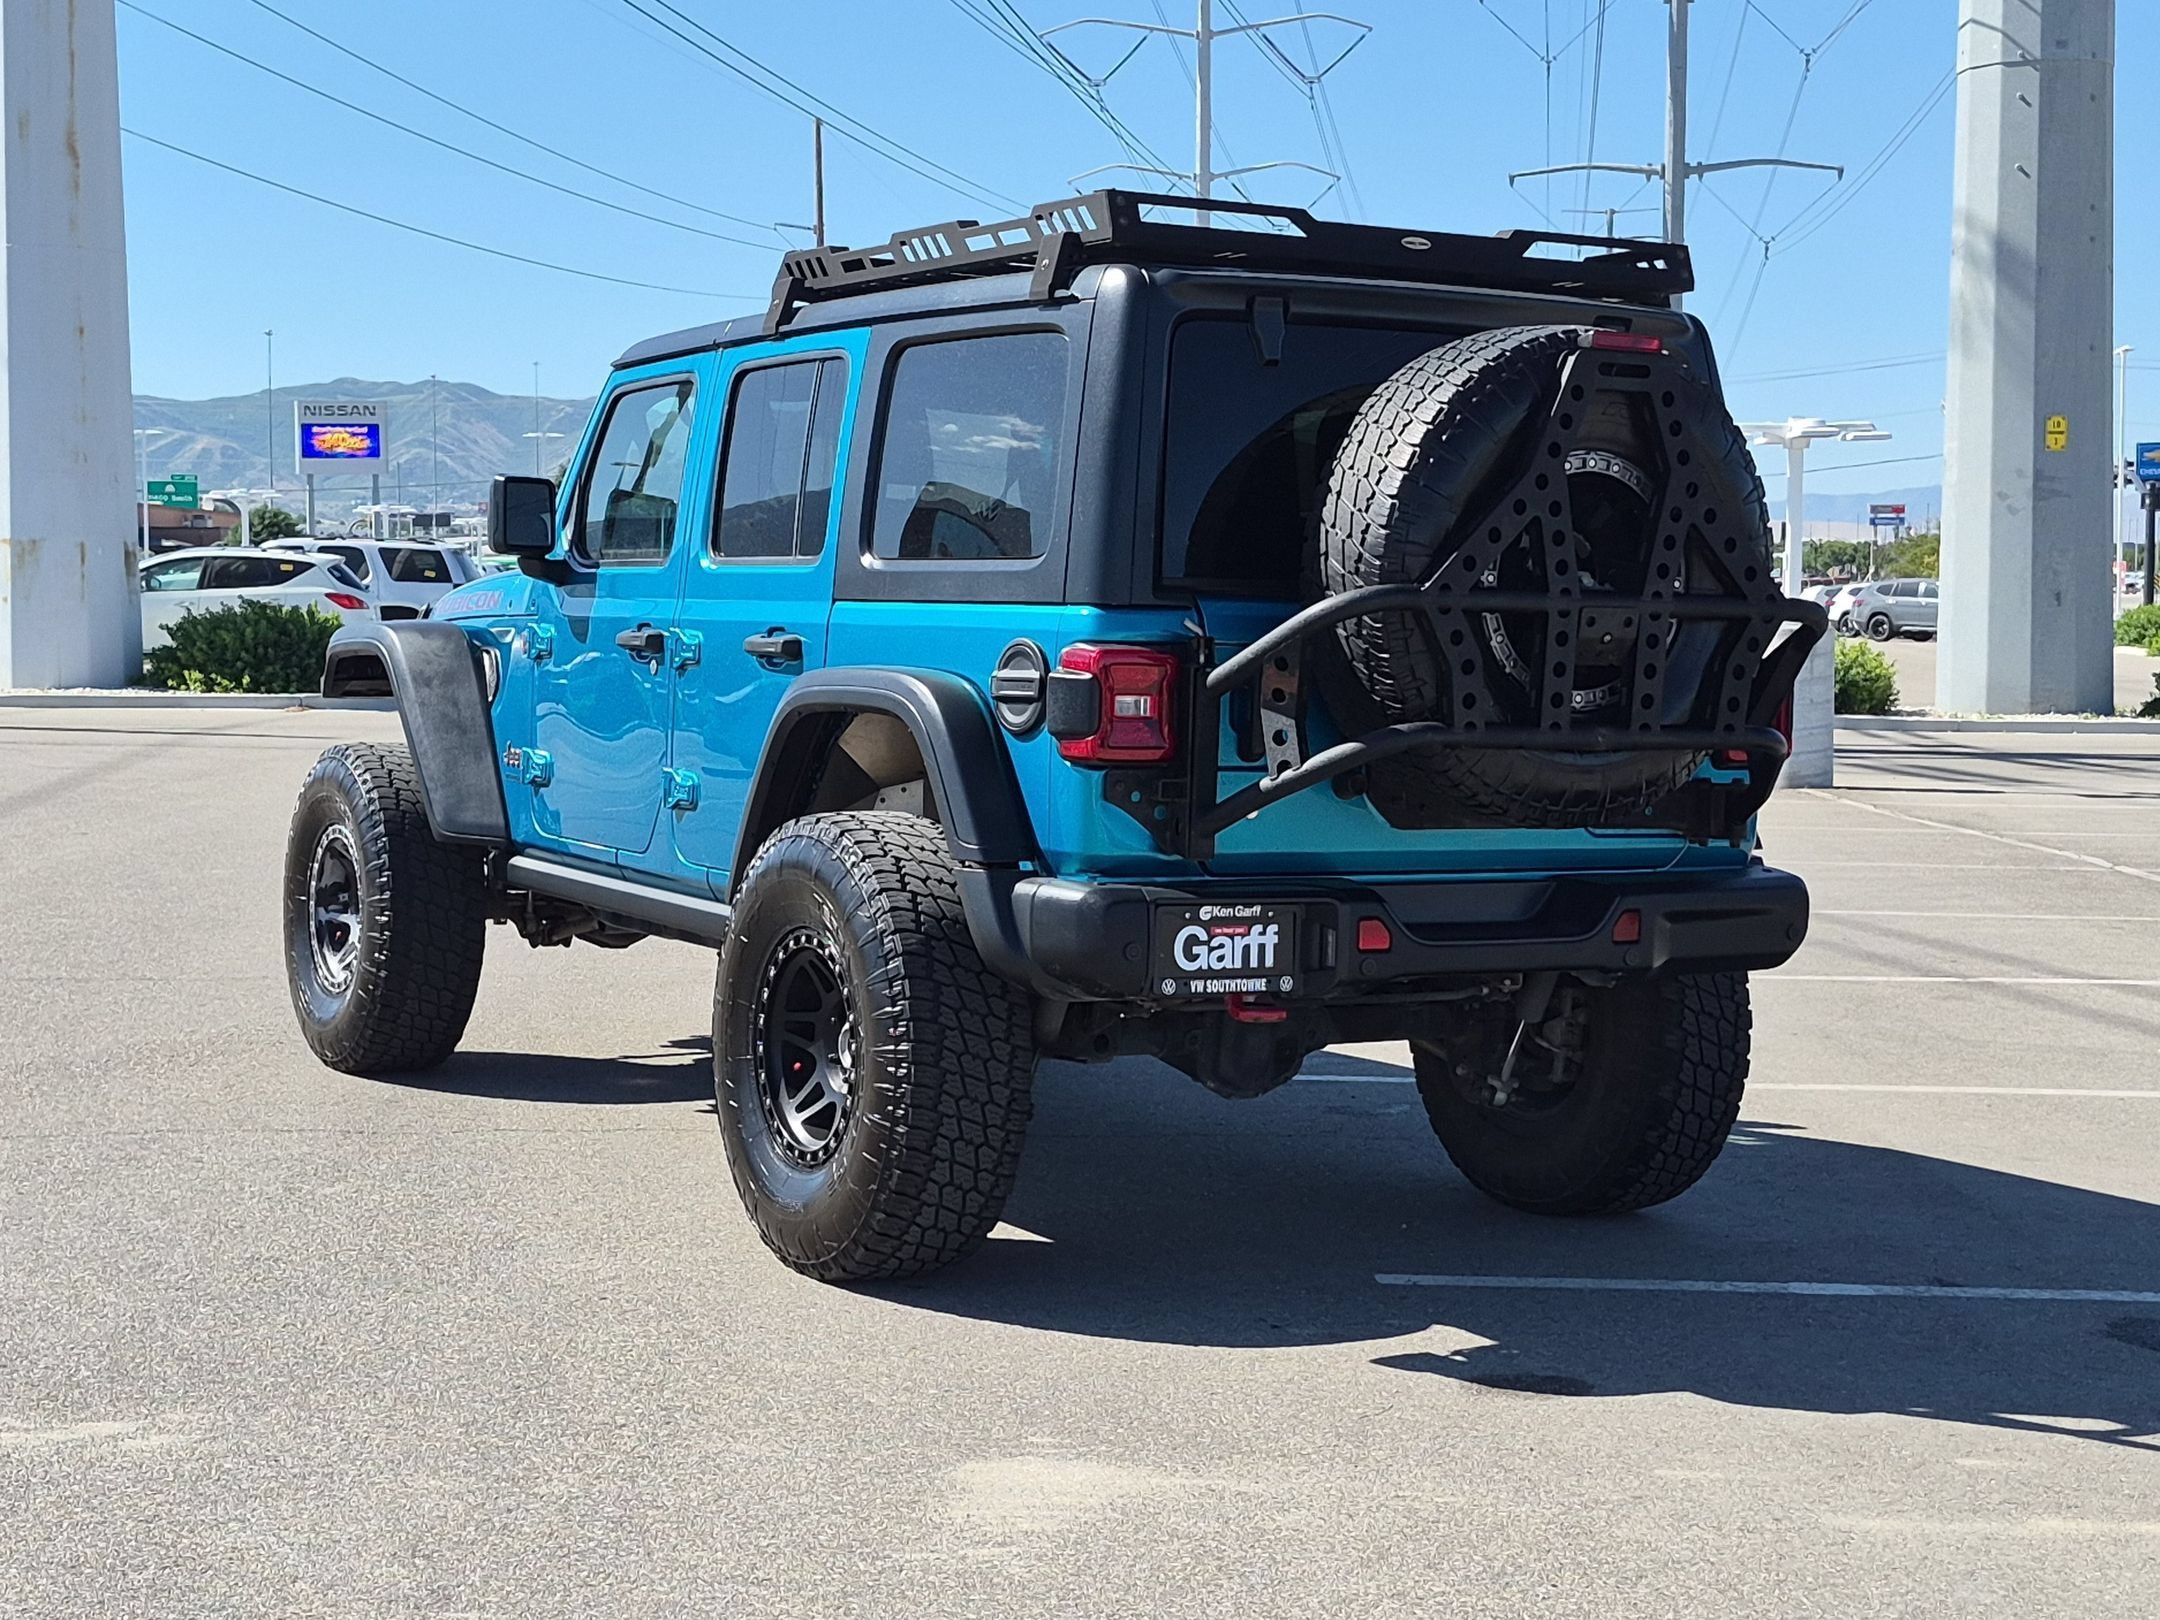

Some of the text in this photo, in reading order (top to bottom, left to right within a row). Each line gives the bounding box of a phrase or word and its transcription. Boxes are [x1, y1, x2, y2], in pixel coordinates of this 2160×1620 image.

[303, 405, 376, 416] NISSAN
[1212, 904, 1262, 917] Ken Garff
[1174, 924, 1279, 971] Garff
[1190, 979, 1205, 993] VW
